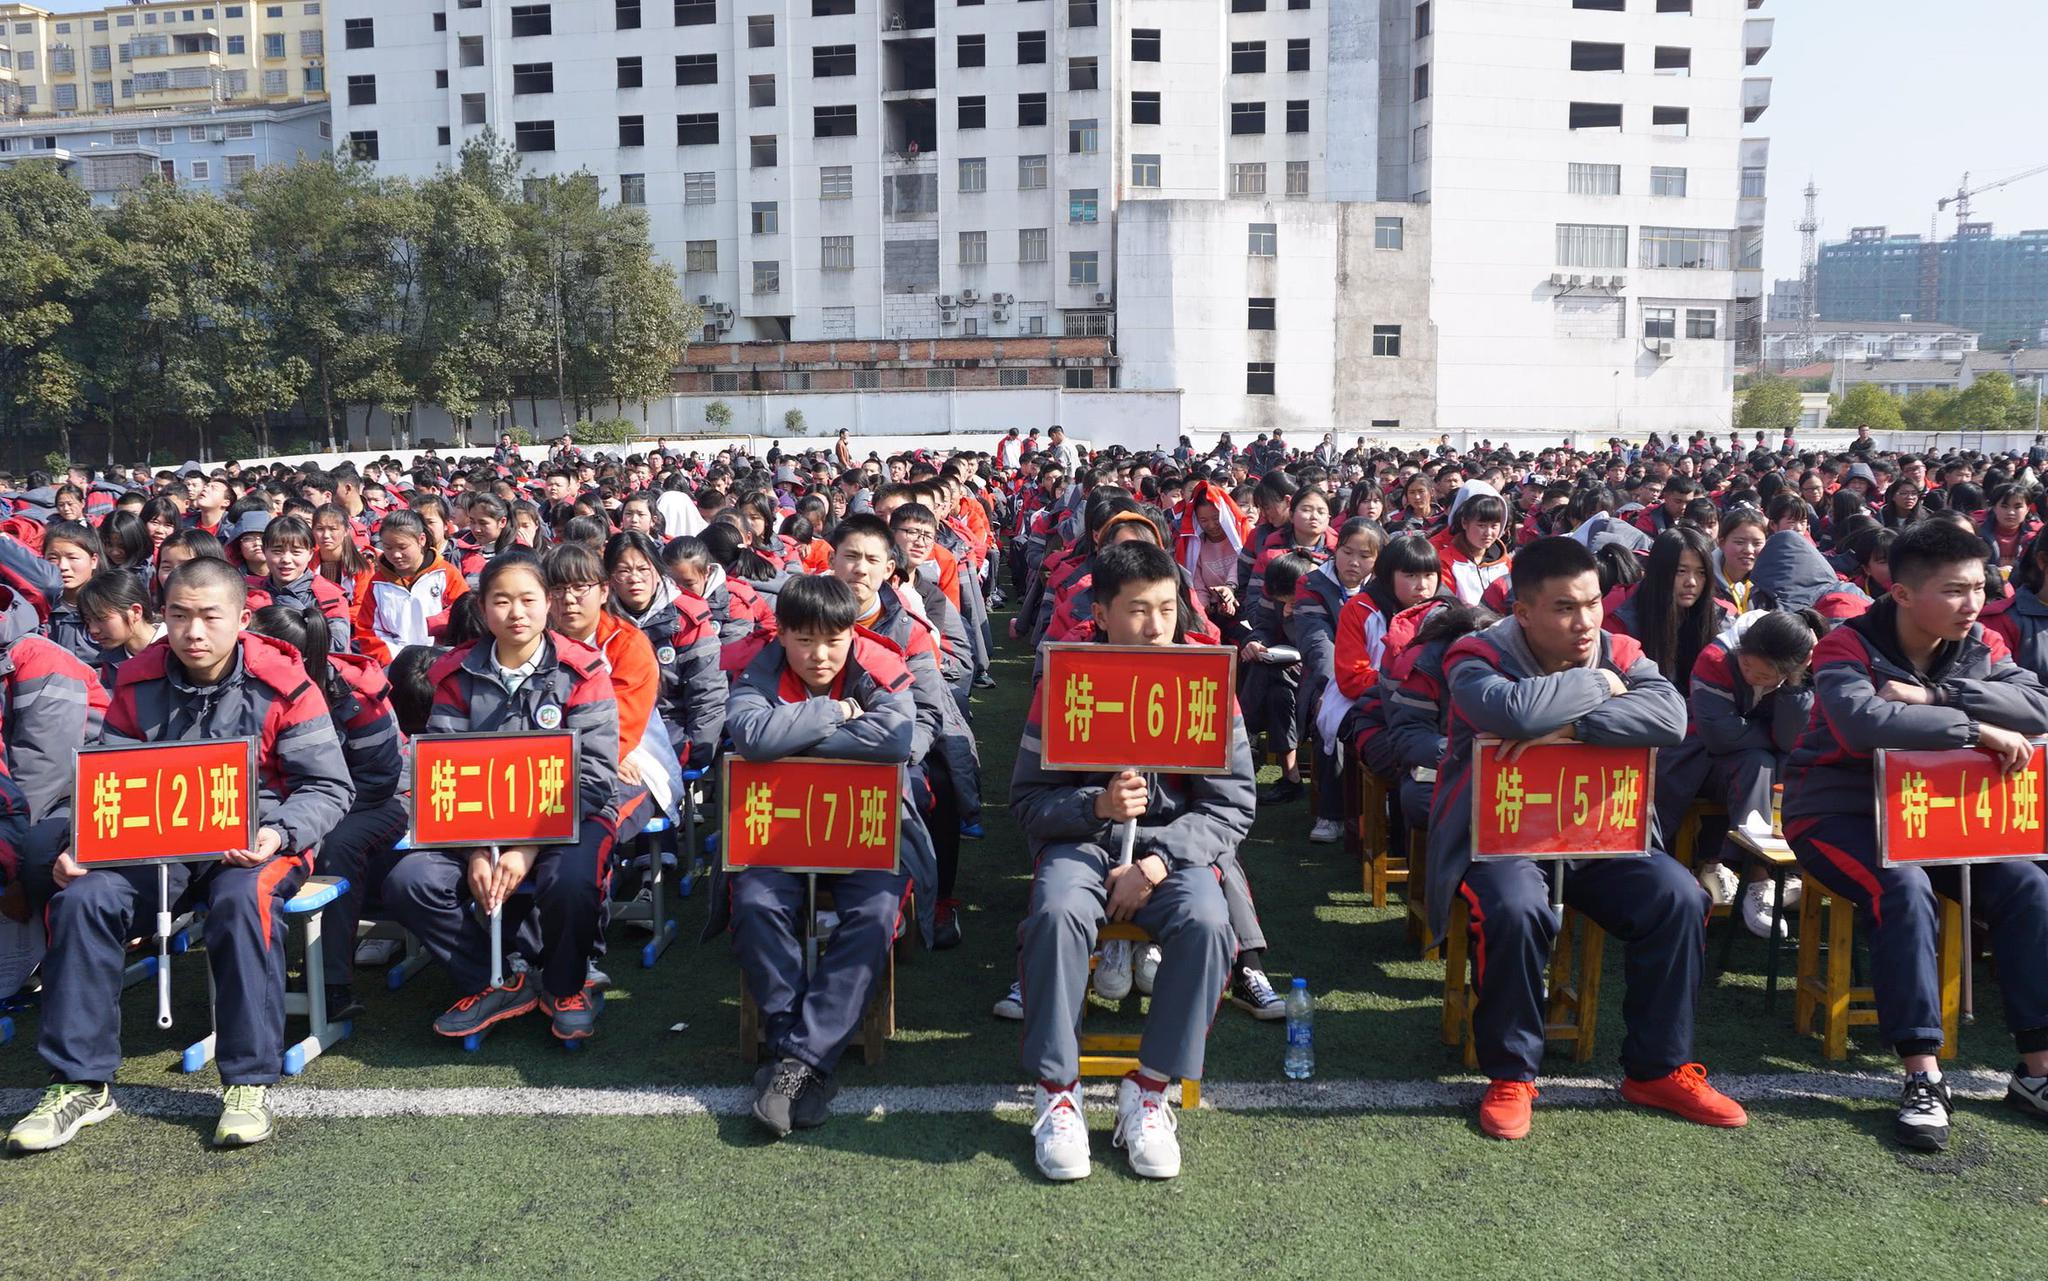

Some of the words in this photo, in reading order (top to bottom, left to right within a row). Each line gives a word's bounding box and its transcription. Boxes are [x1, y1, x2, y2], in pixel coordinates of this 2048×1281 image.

[1065, 673, 1217, 743] 特一(6)班
[93, 764, 240, 838] 特二(2)班
[431, 755, 564, 821] 特二(1)班
[745, 781, 886, 847] 特一(7)班
[1495, 767, 1639, 832] 特一(5)班
[1901, 768, 2039, 838] 特一(4)班
